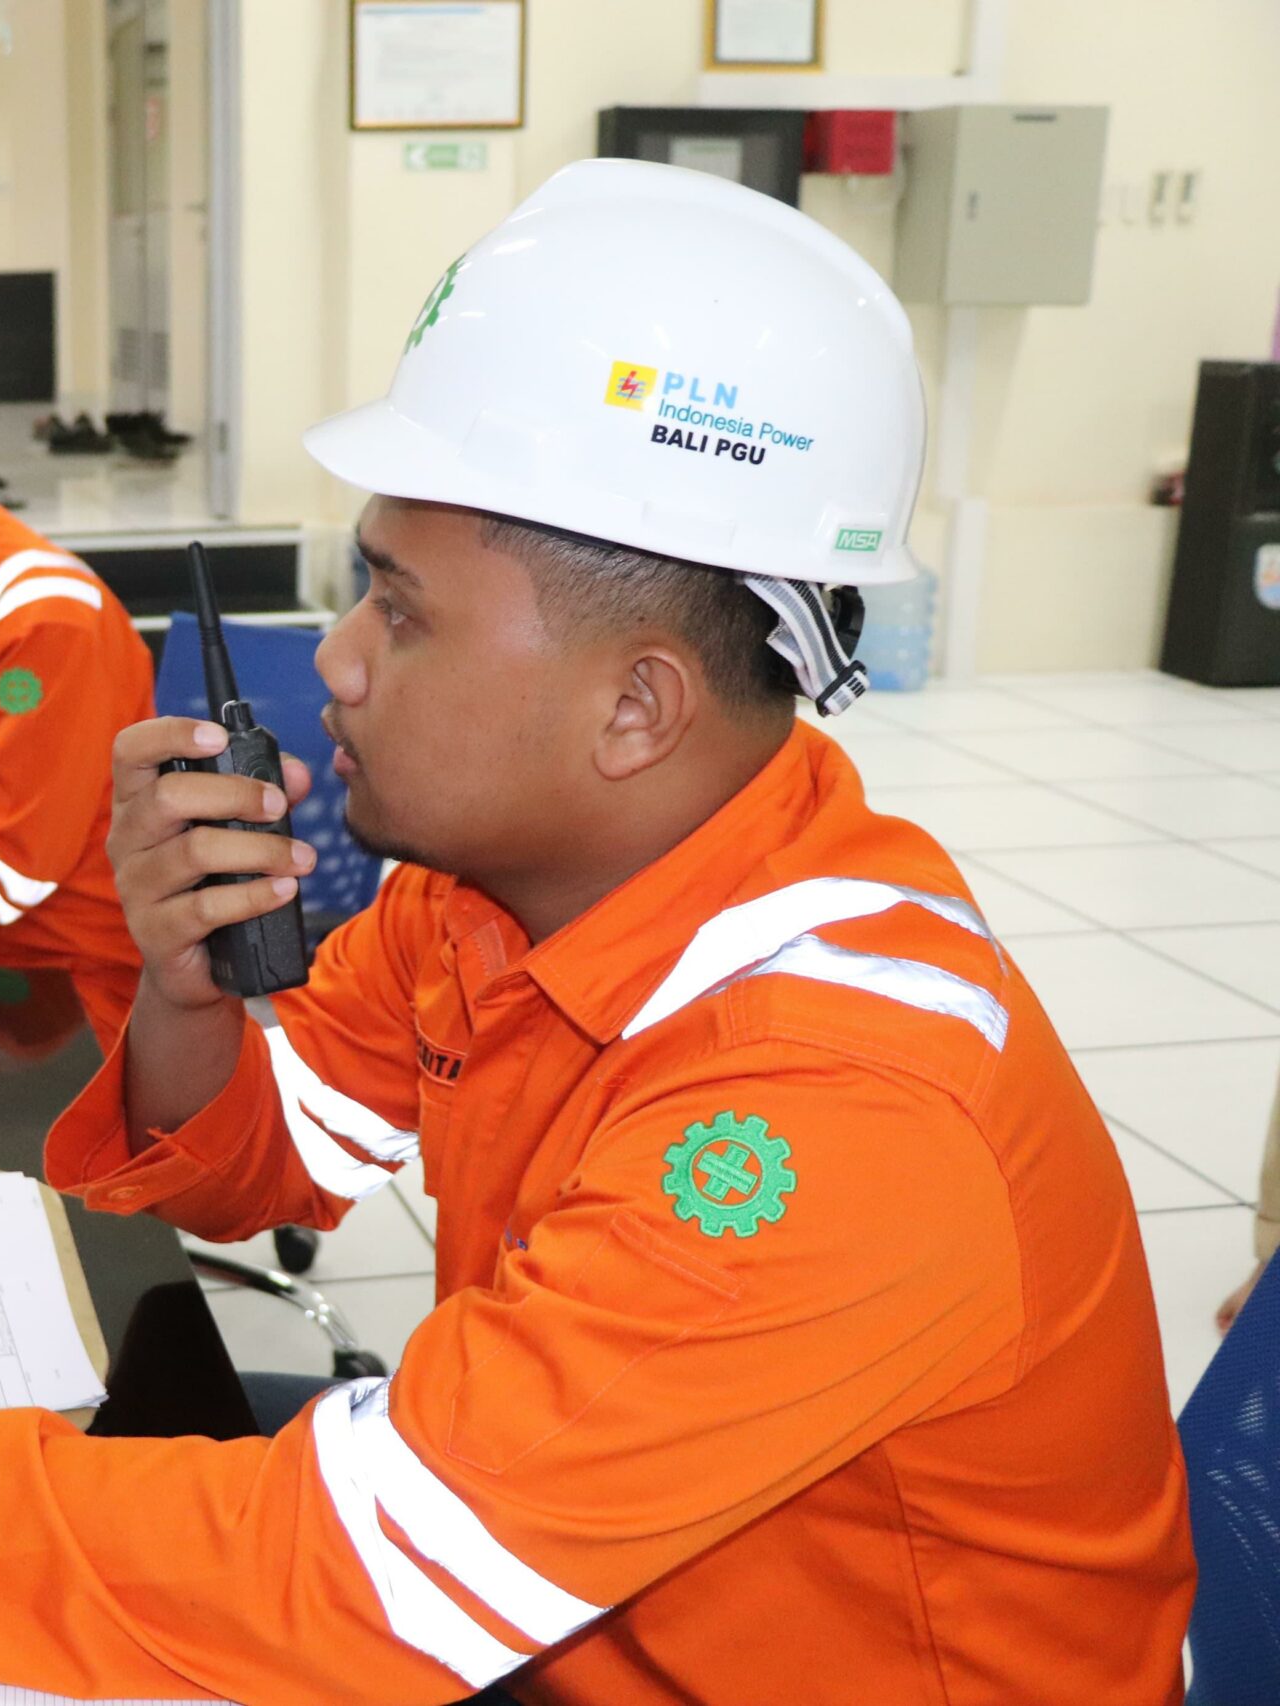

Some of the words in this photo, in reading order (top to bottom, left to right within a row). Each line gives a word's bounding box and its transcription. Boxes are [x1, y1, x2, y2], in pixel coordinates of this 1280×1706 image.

[662, 371, 738, 409] PLN
[651, 424, 709, 453] BALI
[714, 438, 766, 465] PGU
[657, 398, 753, 438] Indonesia
[759, 421, 815, 452] Power
[837, 530, 880, 549] MSA
